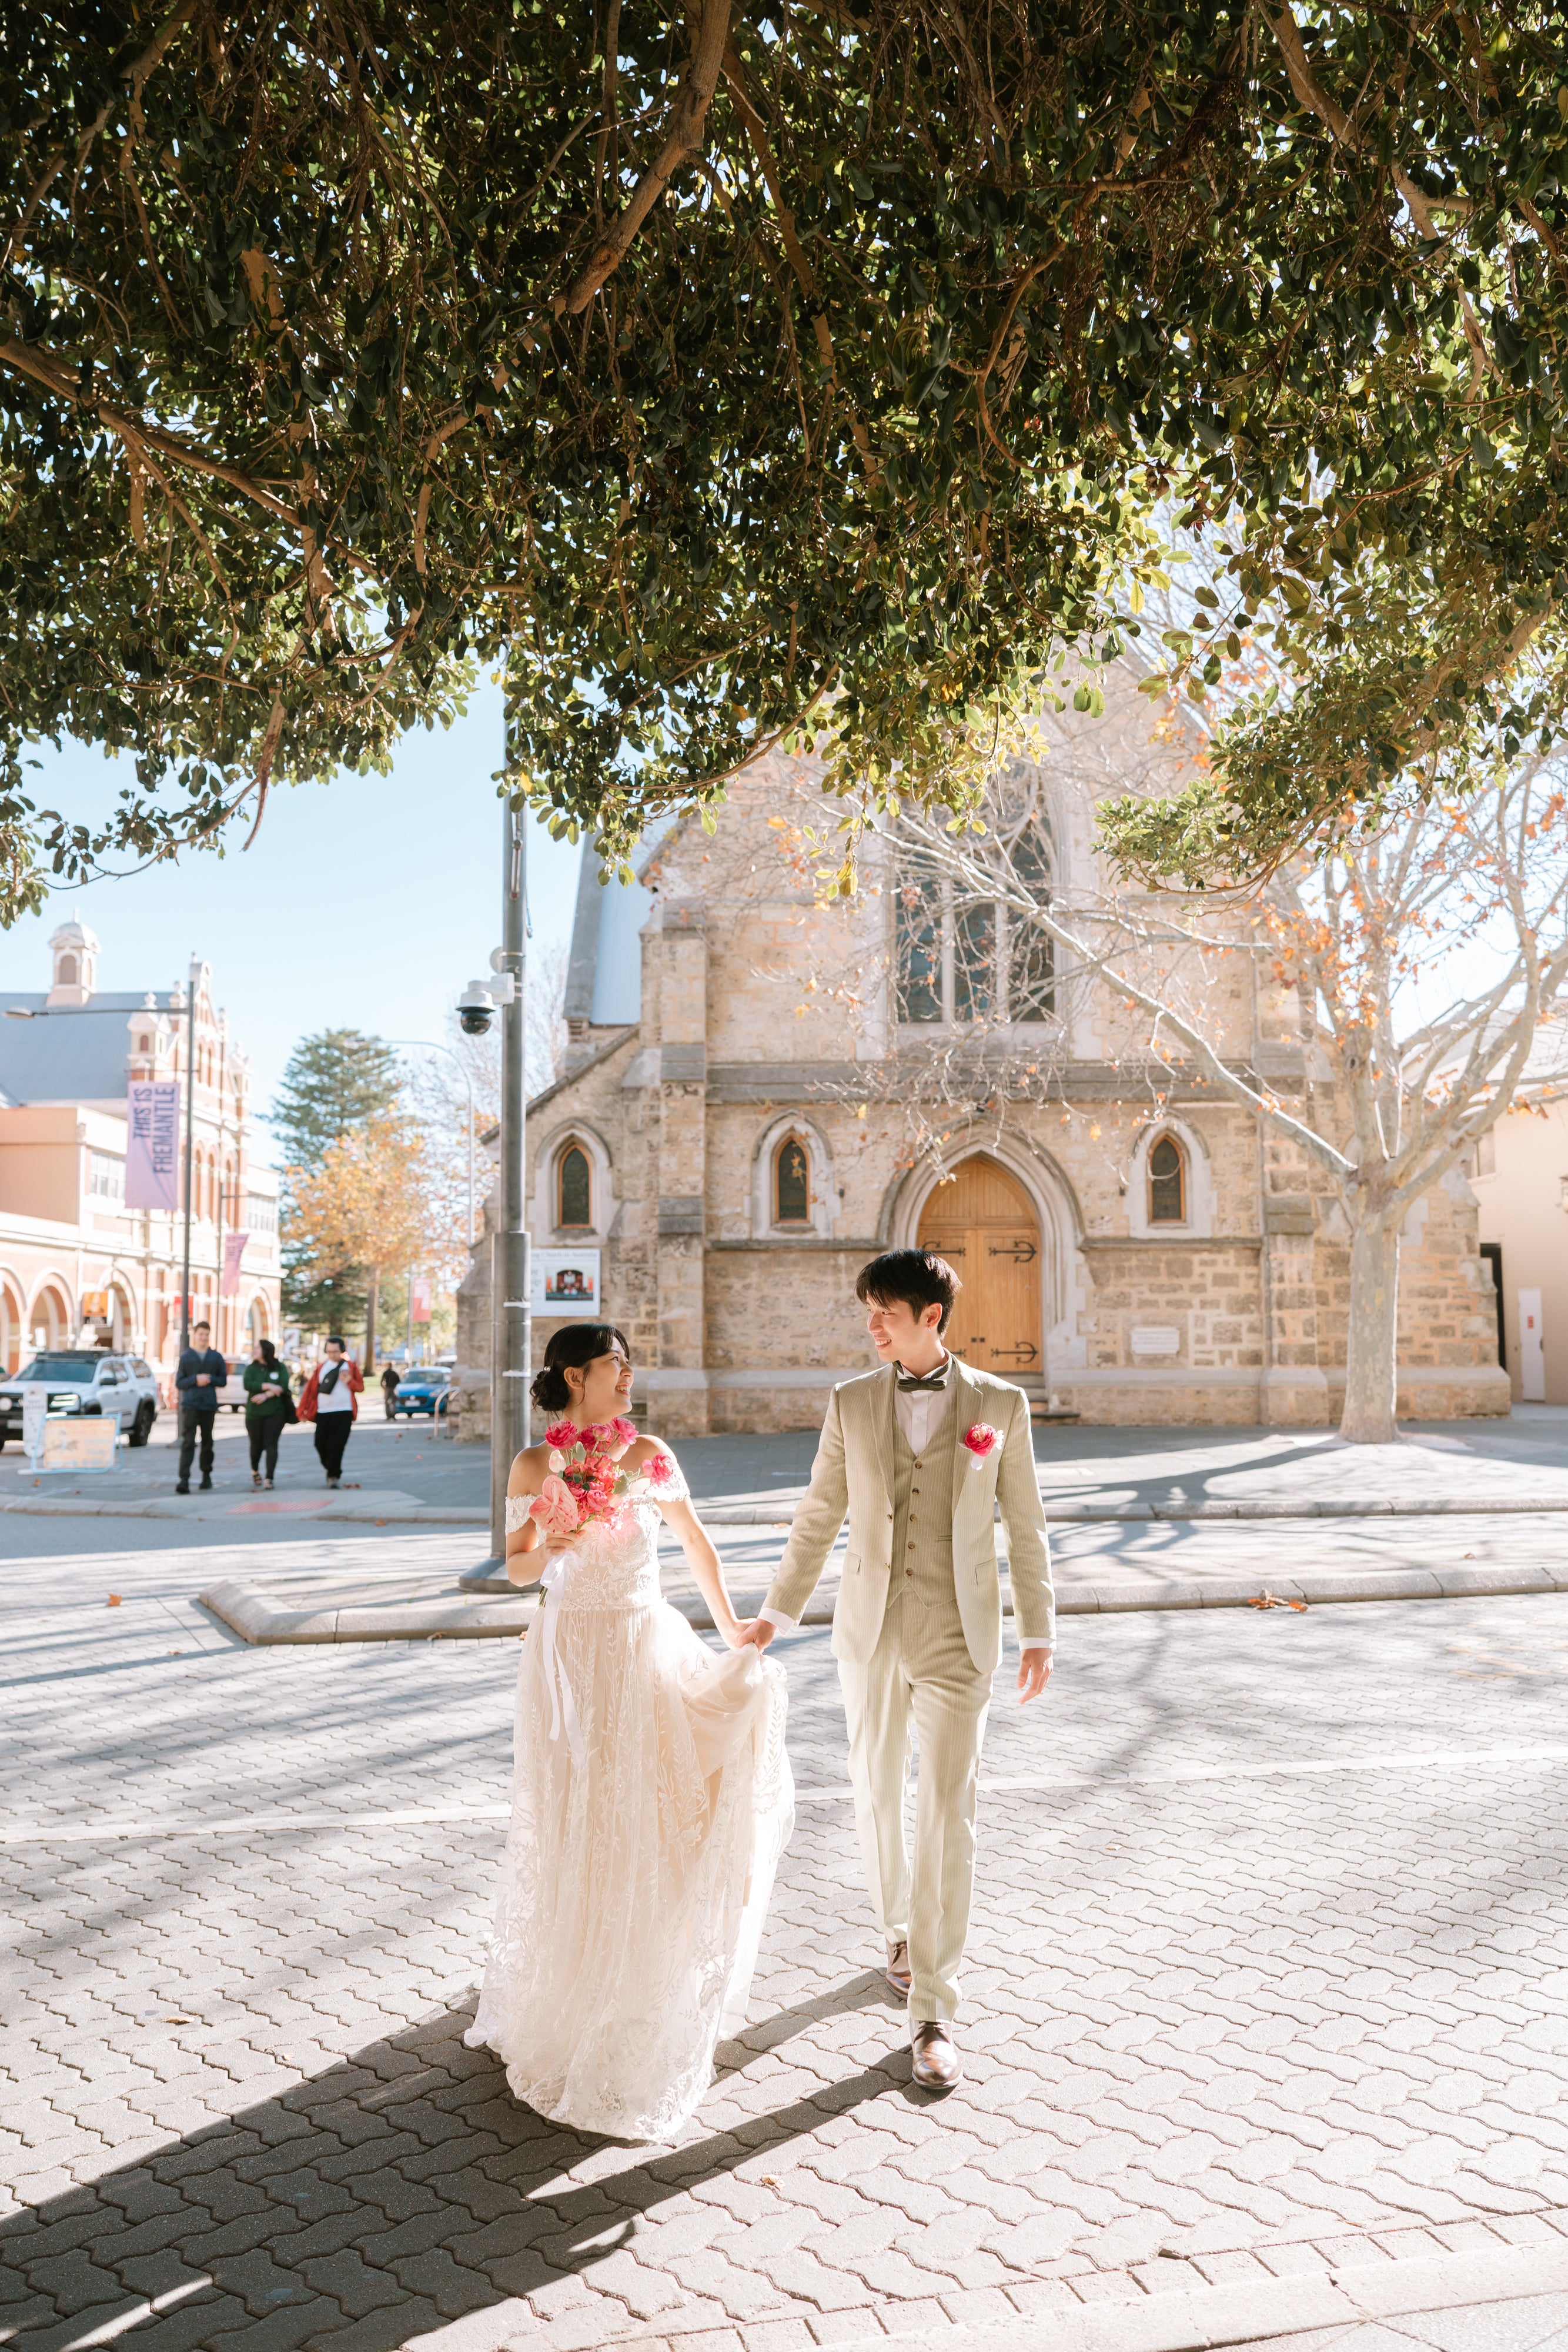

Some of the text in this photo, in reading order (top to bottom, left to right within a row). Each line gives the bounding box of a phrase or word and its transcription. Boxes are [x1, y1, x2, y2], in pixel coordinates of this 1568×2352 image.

[133, 1088, 152, 1140] THIS IS
[152, 1087, 175, 1173] FREMANTLE
